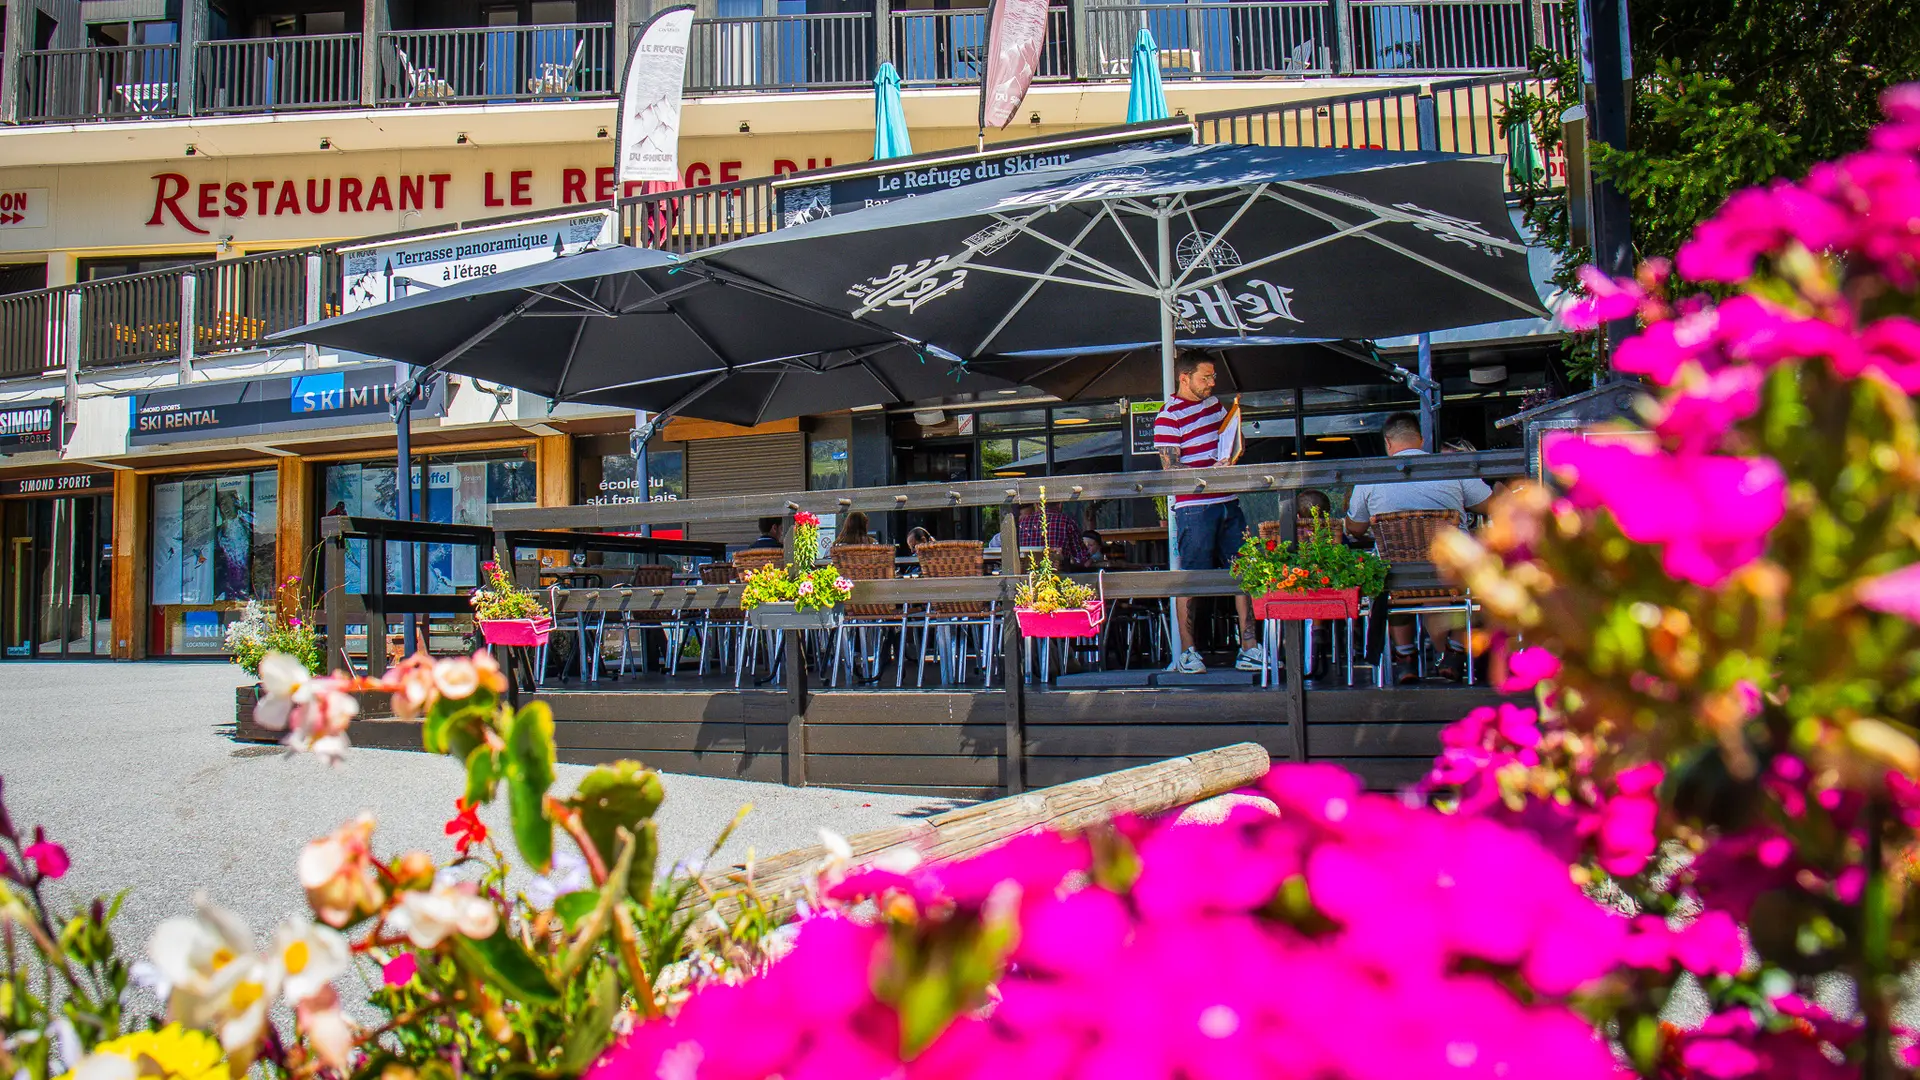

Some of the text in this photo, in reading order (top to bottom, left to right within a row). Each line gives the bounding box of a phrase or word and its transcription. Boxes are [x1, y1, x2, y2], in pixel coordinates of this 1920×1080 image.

[878, 153, 1070, 192] Le Refuge du Skieur
[145, 172, 451, 235] RESTAURANT
[484, 169, 533, 207] LE
[562, 161, 743, 204] REFGE
[396, 233, 548, 267] Terrasse panoramique
[443, 266, 451, 281] à
[161, 404, 181, 412] SPORTS
[0, 408, 52, 435] SIMOND
[140, 409, 220, 432] SKI RENTAL
[20, 433, 51, 445] SPORTS
[20, 475, 91, 493] SIMOND SPORTS
[599, 477, 640, 491] école
